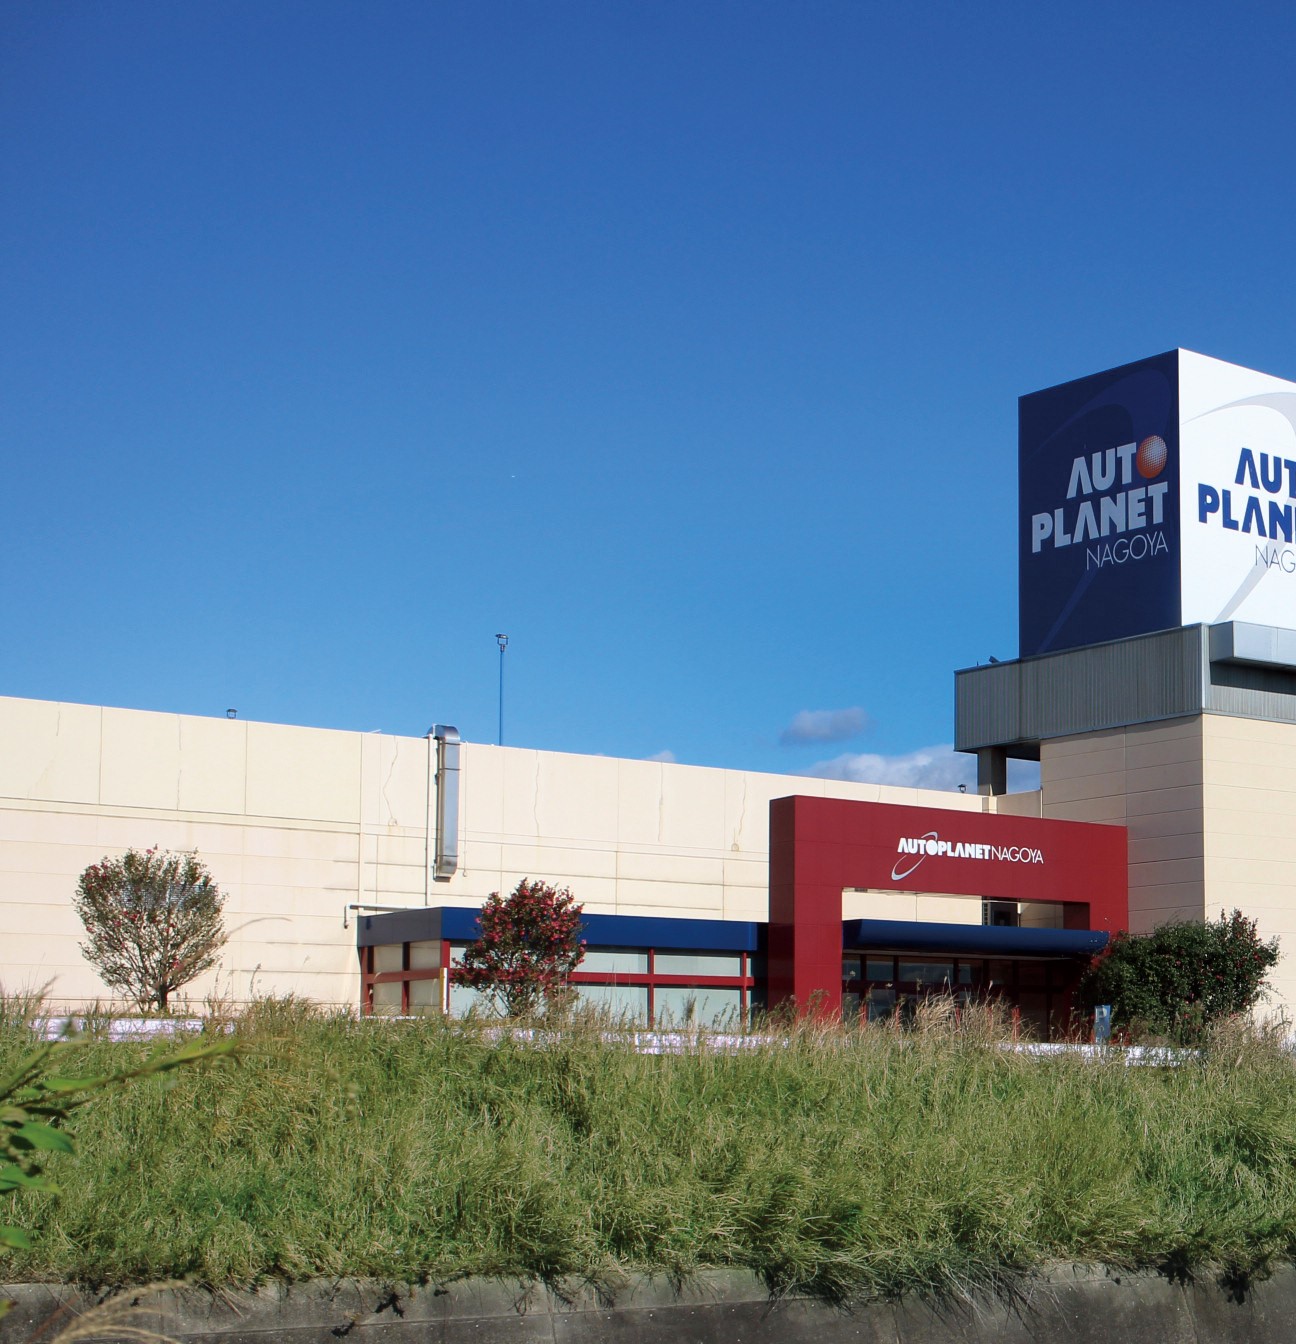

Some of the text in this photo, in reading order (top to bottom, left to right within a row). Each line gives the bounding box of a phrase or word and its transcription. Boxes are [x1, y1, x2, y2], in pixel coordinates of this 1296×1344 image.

[1066, 435, 1167, 499] AUTO
[1032, 481, 1168, 553] PLANET
[1086, 531, 1168, 570] NAGOYA
